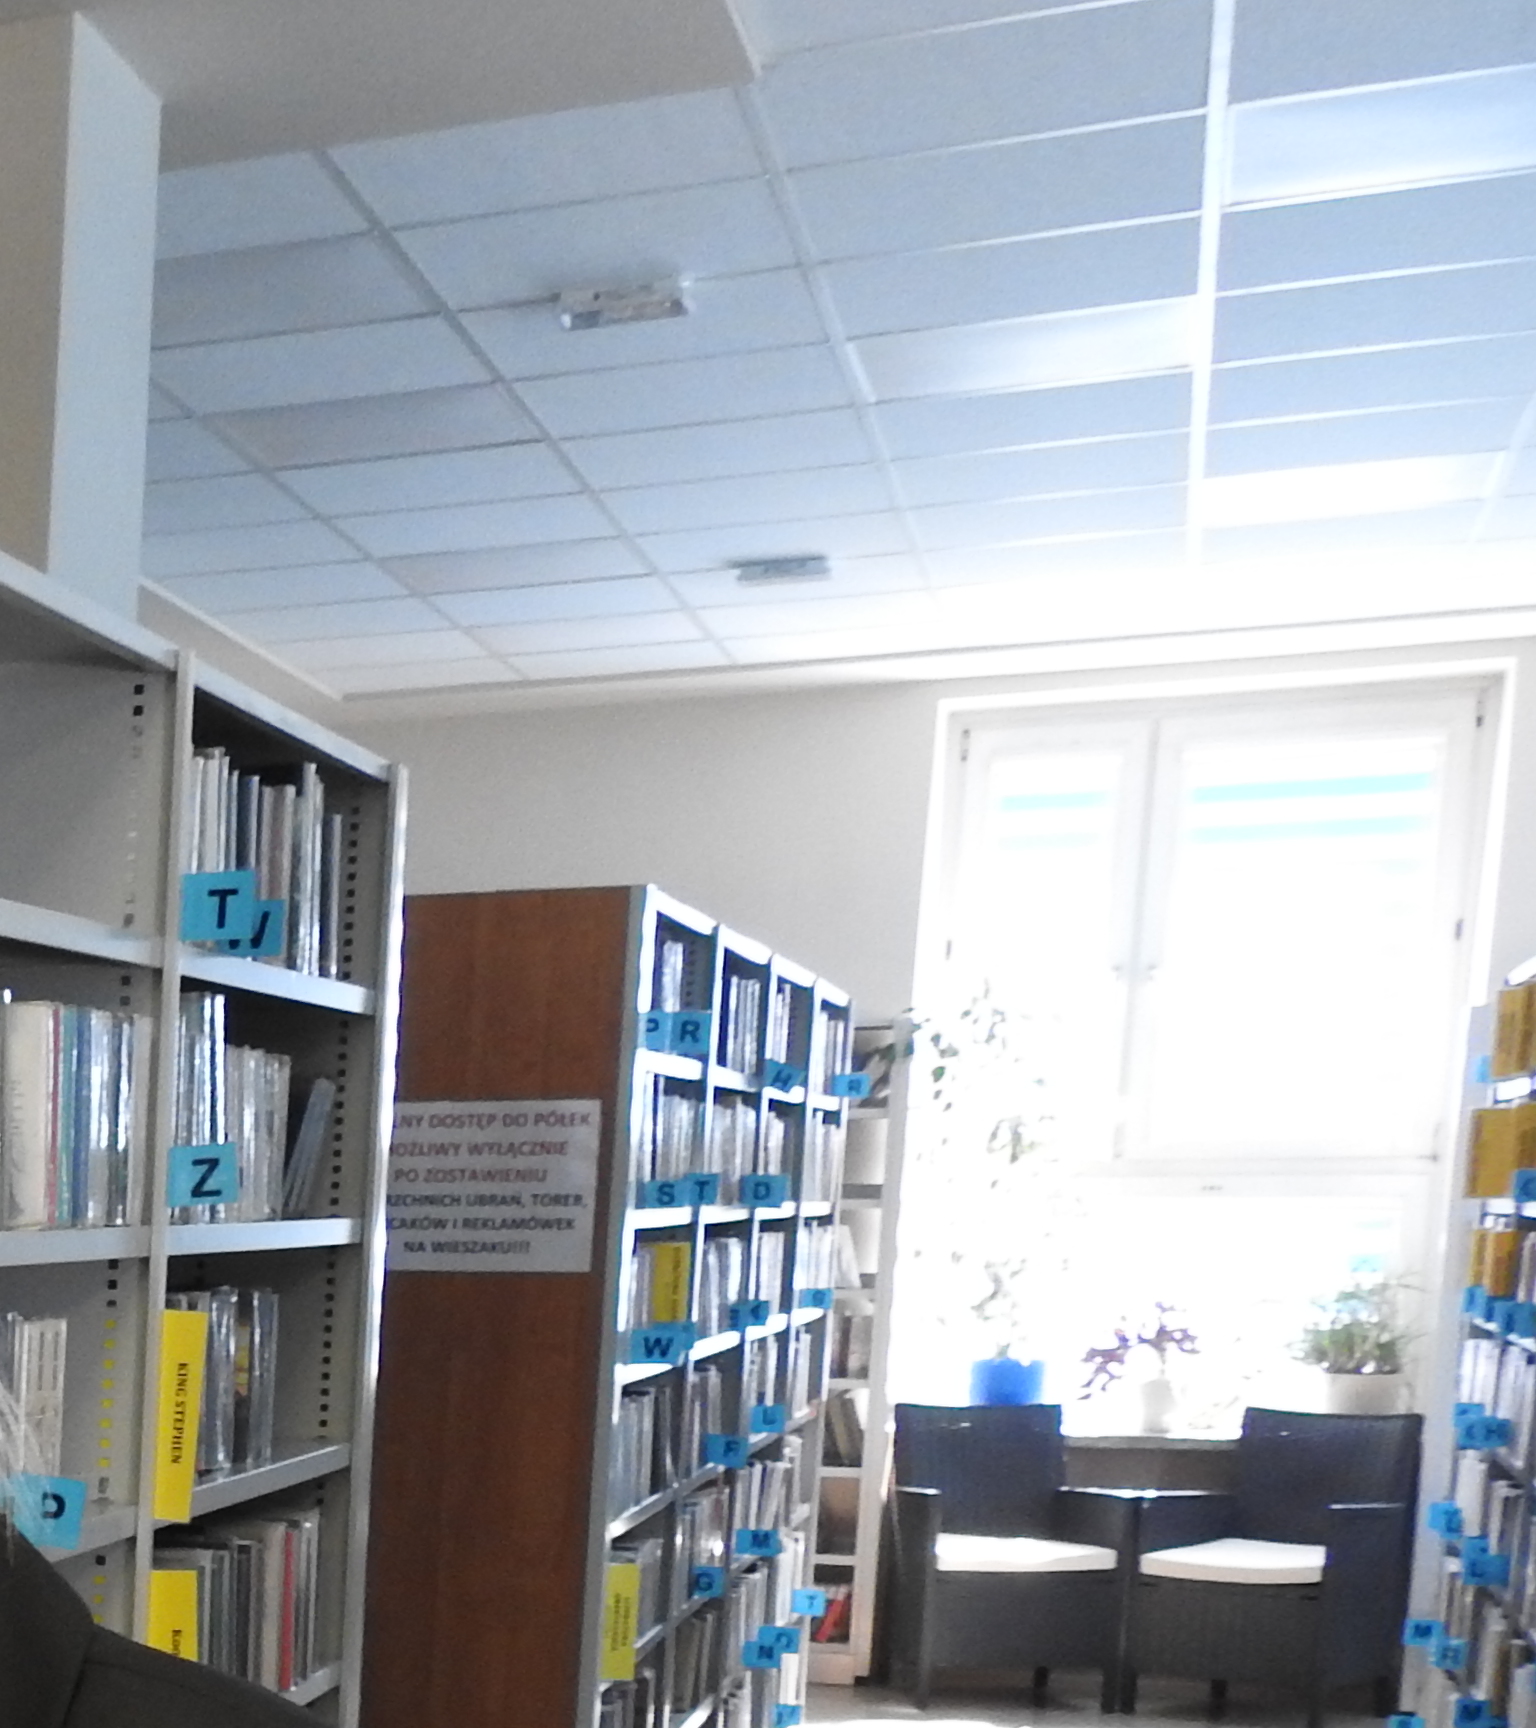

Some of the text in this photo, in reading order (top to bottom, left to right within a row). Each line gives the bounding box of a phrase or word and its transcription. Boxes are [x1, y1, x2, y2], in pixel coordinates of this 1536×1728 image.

[206, 888, 239, 930] T
[679, 1020, 700, 1043] R
[502, 1112, 528, 1128] DO
[389, 1141, 462, 1158] OŻLIWY
[189, 1156, 223, 1198] Z
[643, 1336, 675, 1358] W
[169, 1361, 190, 1465] KING STEPHEN
